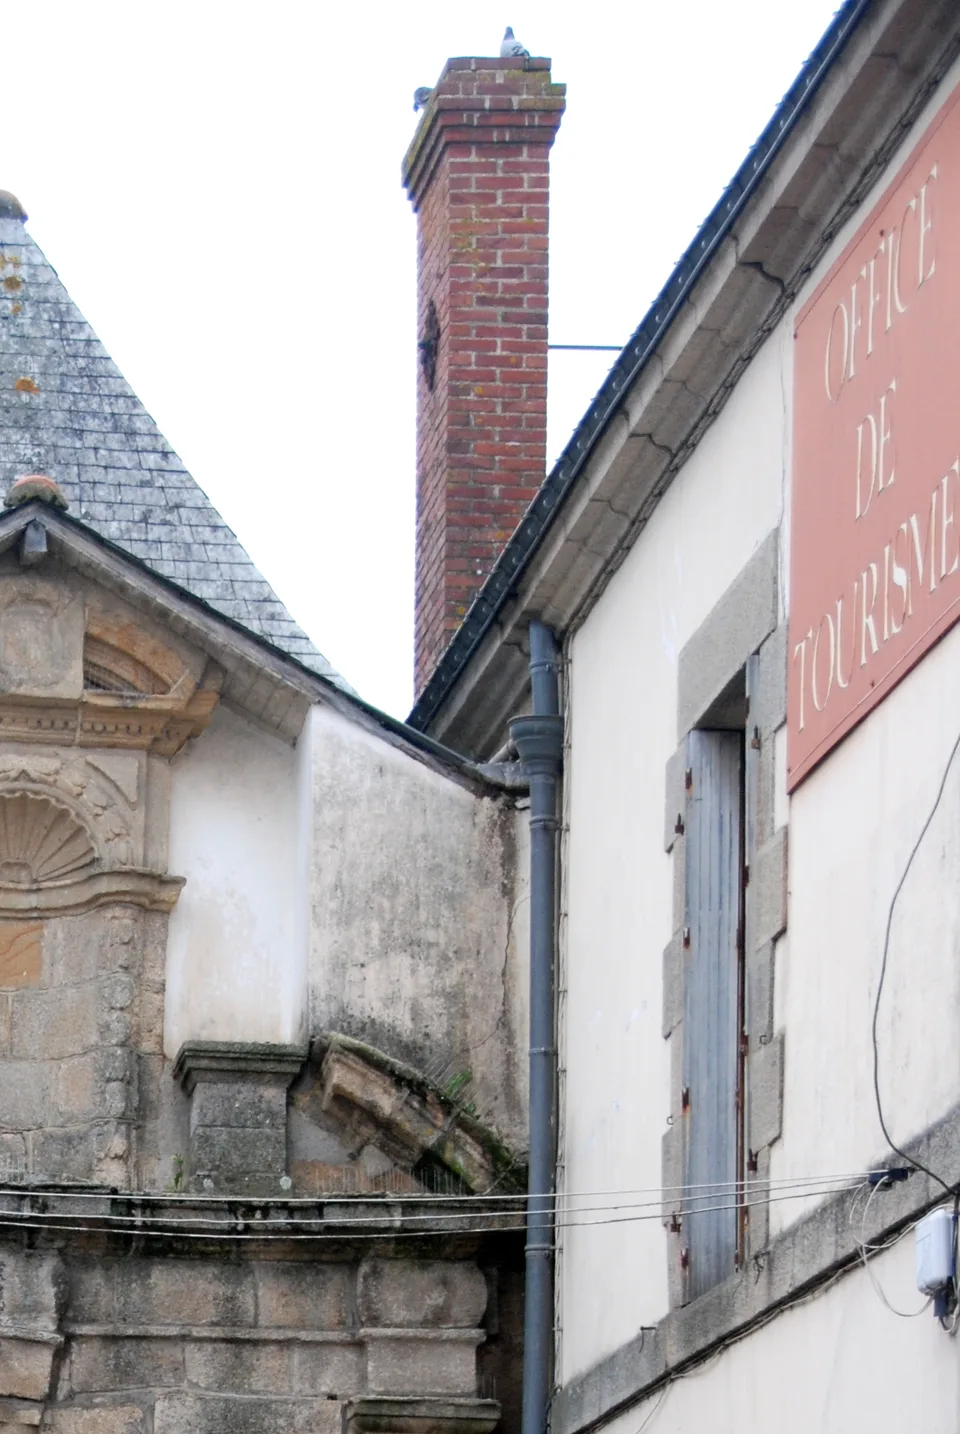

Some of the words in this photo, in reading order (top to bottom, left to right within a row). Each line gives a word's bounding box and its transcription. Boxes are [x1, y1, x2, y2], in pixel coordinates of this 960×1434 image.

[824, 159, 939, 404] OFFICE
[854, 378, 897, 521] DE
[794, 455, 960, 733] TOURISME
